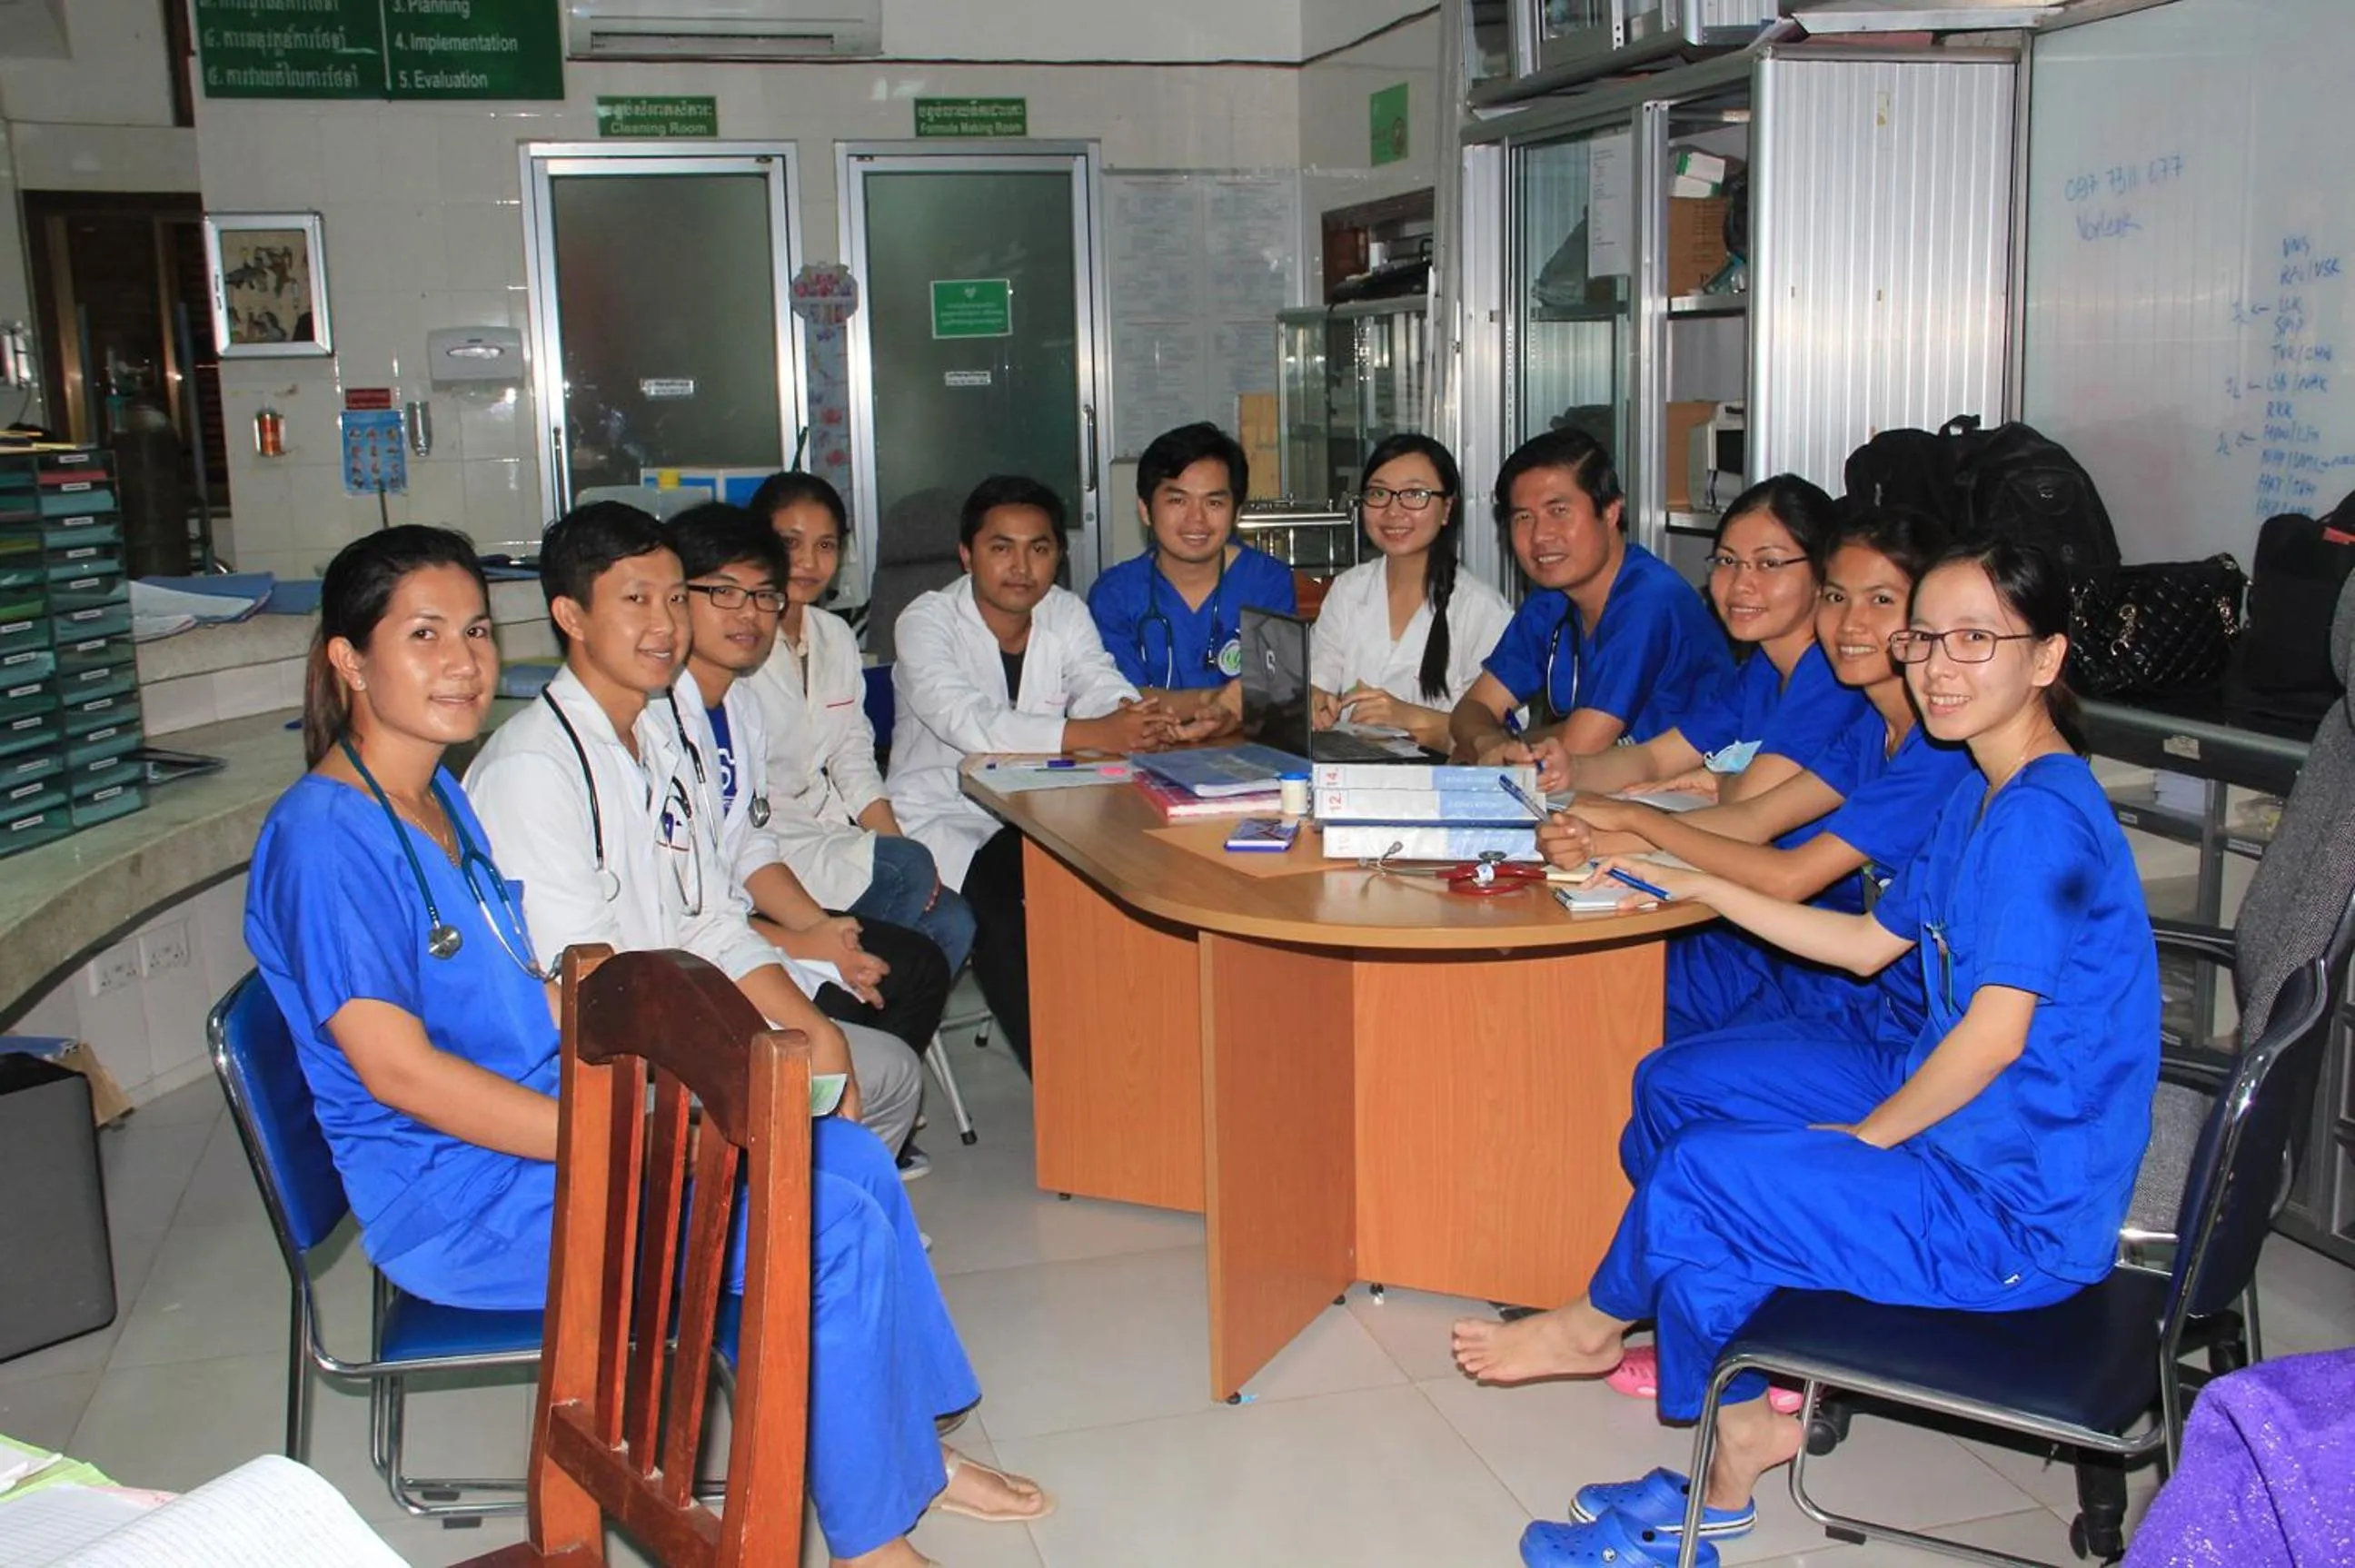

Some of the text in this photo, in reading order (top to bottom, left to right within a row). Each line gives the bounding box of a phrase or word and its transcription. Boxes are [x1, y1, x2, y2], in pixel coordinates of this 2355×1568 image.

[409, 0, 471, 19] Planning
[394, 32, 519, 55] 4. Implementation
[399, 69, 489, 89] 5. Evaluation
[611, 121, 708, 136] Cleaning Room
